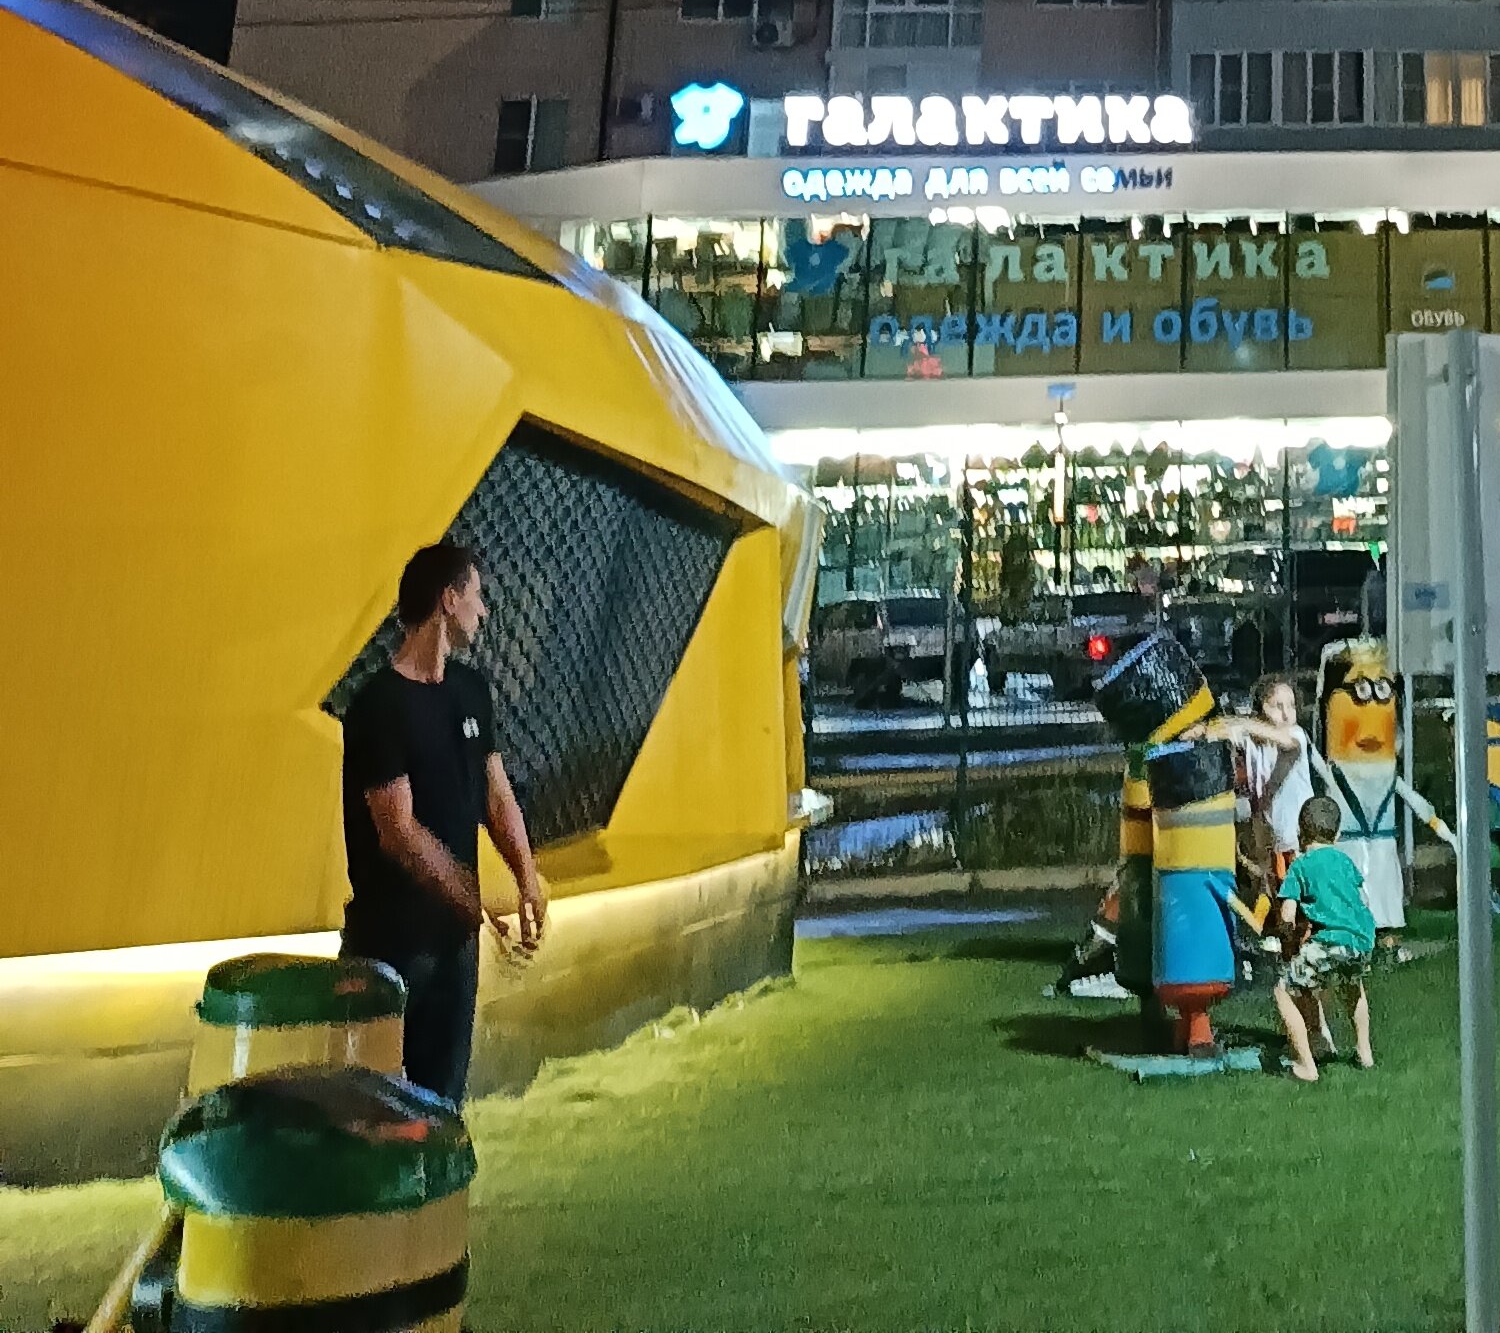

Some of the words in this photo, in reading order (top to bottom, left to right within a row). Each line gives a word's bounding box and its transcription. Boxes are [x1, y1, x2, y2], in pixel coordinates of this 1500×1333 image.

[783, 96, 1193, 147] галактика
[783, 167, 913, 201] одежда
[925, 167, 989, 201] для
[999, 158, 1070, 194] всей
[1080, 166, 1173, 195] семьи
[1102, 311, 1132, 344] и
[1153, 297, 1314, 351] обувь
